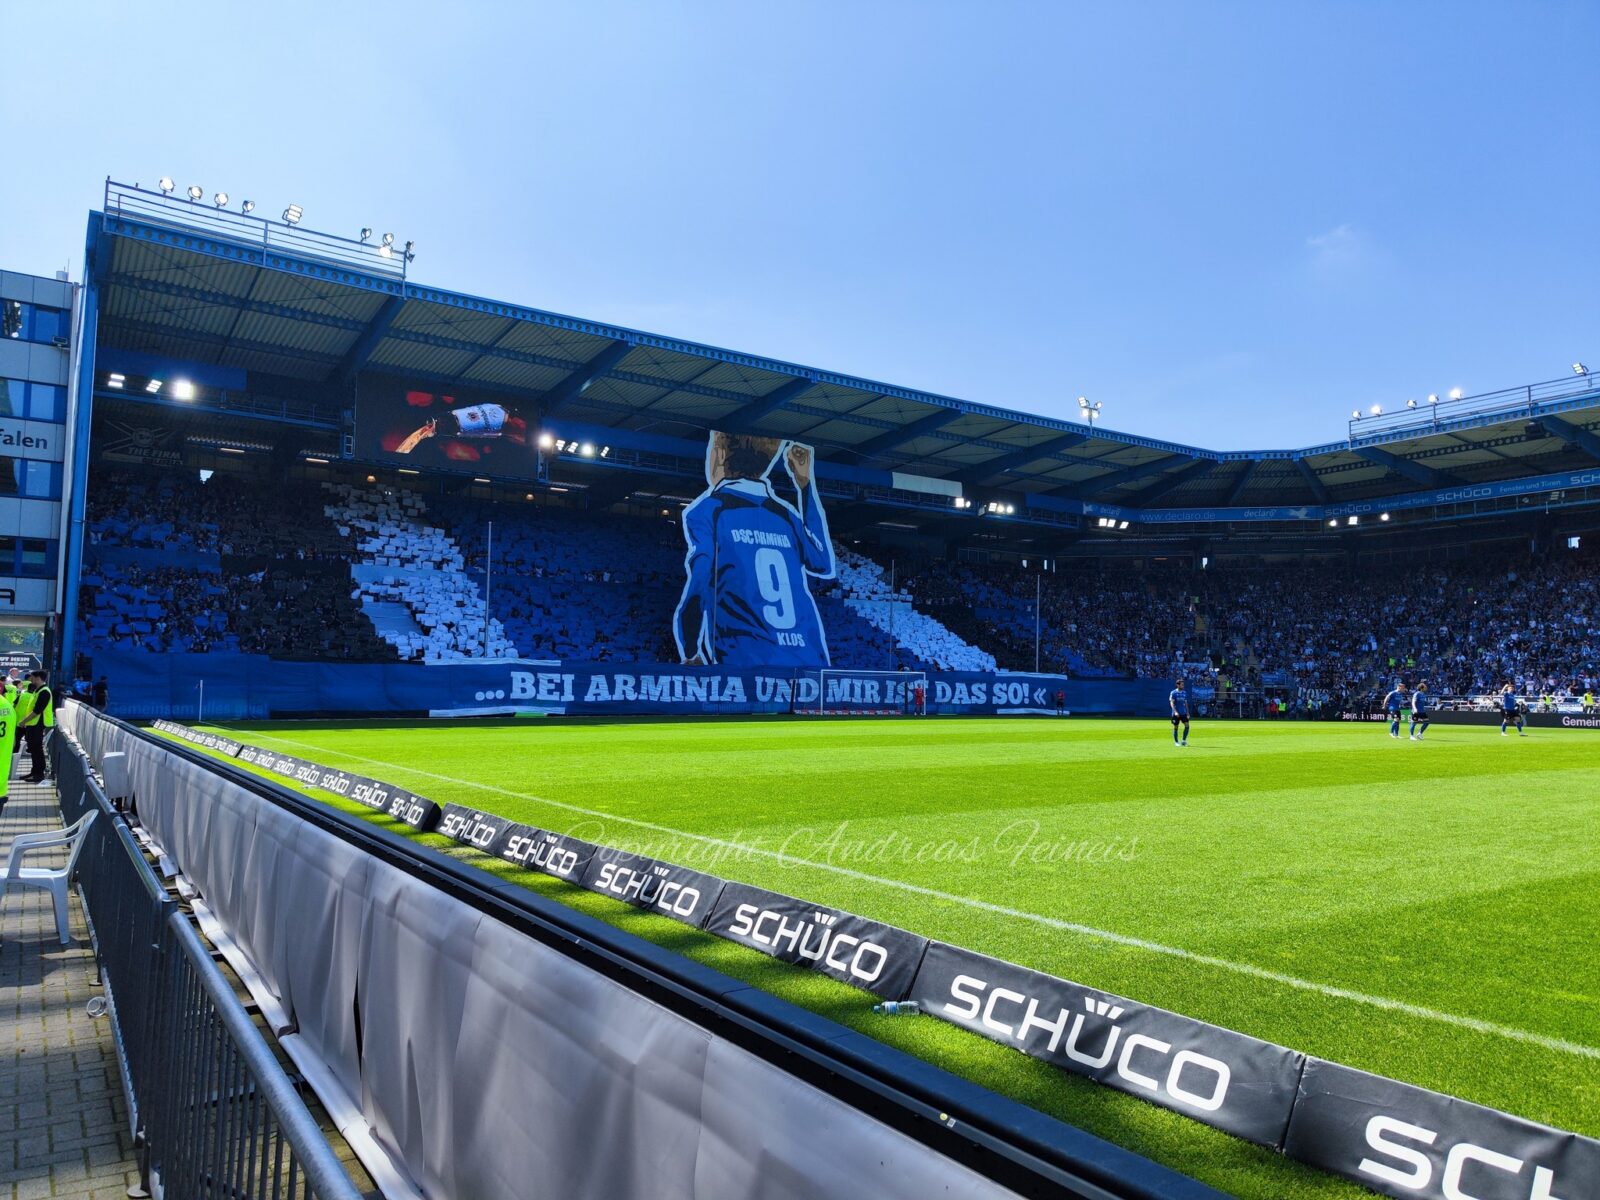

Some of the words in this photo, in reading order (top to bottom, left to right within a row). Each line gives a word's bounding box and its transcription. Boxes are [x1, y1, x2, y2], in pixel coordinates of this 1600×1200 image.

[1436, 487, 1492, 502] SCHÜCO
[1499, 485, 1525, 493] Fenster
[1526, 482, 1540, 490] und
[1139, 511, 1216, 522] www.declaro.de
[1325, 503, 1372, 517] SCHÜCO
[731, 528, 754, 545] DSC
[754, 547, 797, 630] 9
[776, 631, 806, 647] KLOS
[584, 673, 747, 703] ARMINIA
[755, 676, 819, 703] UND
[826, 677, 881, 704] MIR
[934, 681, 988, 705] DAS
[320, 772, 350, 794] SCHÜCO
[351, 782, 389, 807] SCHÜCO
[388, 796, 425, 825] SCHÜCO
[439, 813, 497, 847] SCHÜCO
[503, 834, 579, 876] SCHÜCO
[595, 866, 701, 917] SCHÜCO
[728, 903, 888, 982] SCHÜCO
[942, 974, 1231, 1111] SCHÜCO
